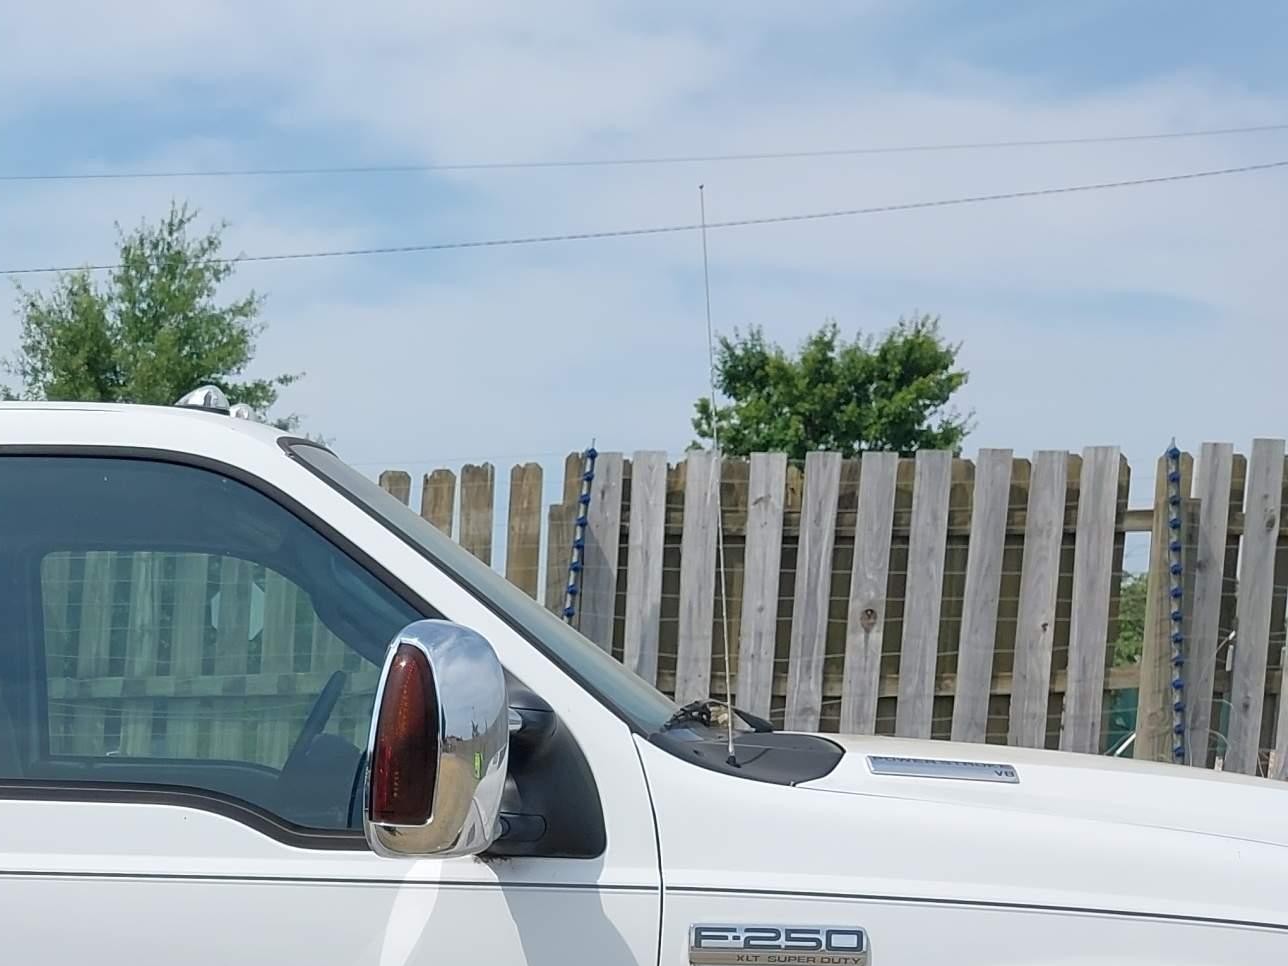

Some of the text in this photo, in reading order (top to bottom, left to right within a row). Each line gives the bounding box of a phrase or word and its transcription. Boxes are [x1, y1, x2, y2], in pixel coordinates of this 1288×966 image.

[694, 926, 864, 953] F-250
[736, 954, 862, 965] XLT SUPER DUTY
